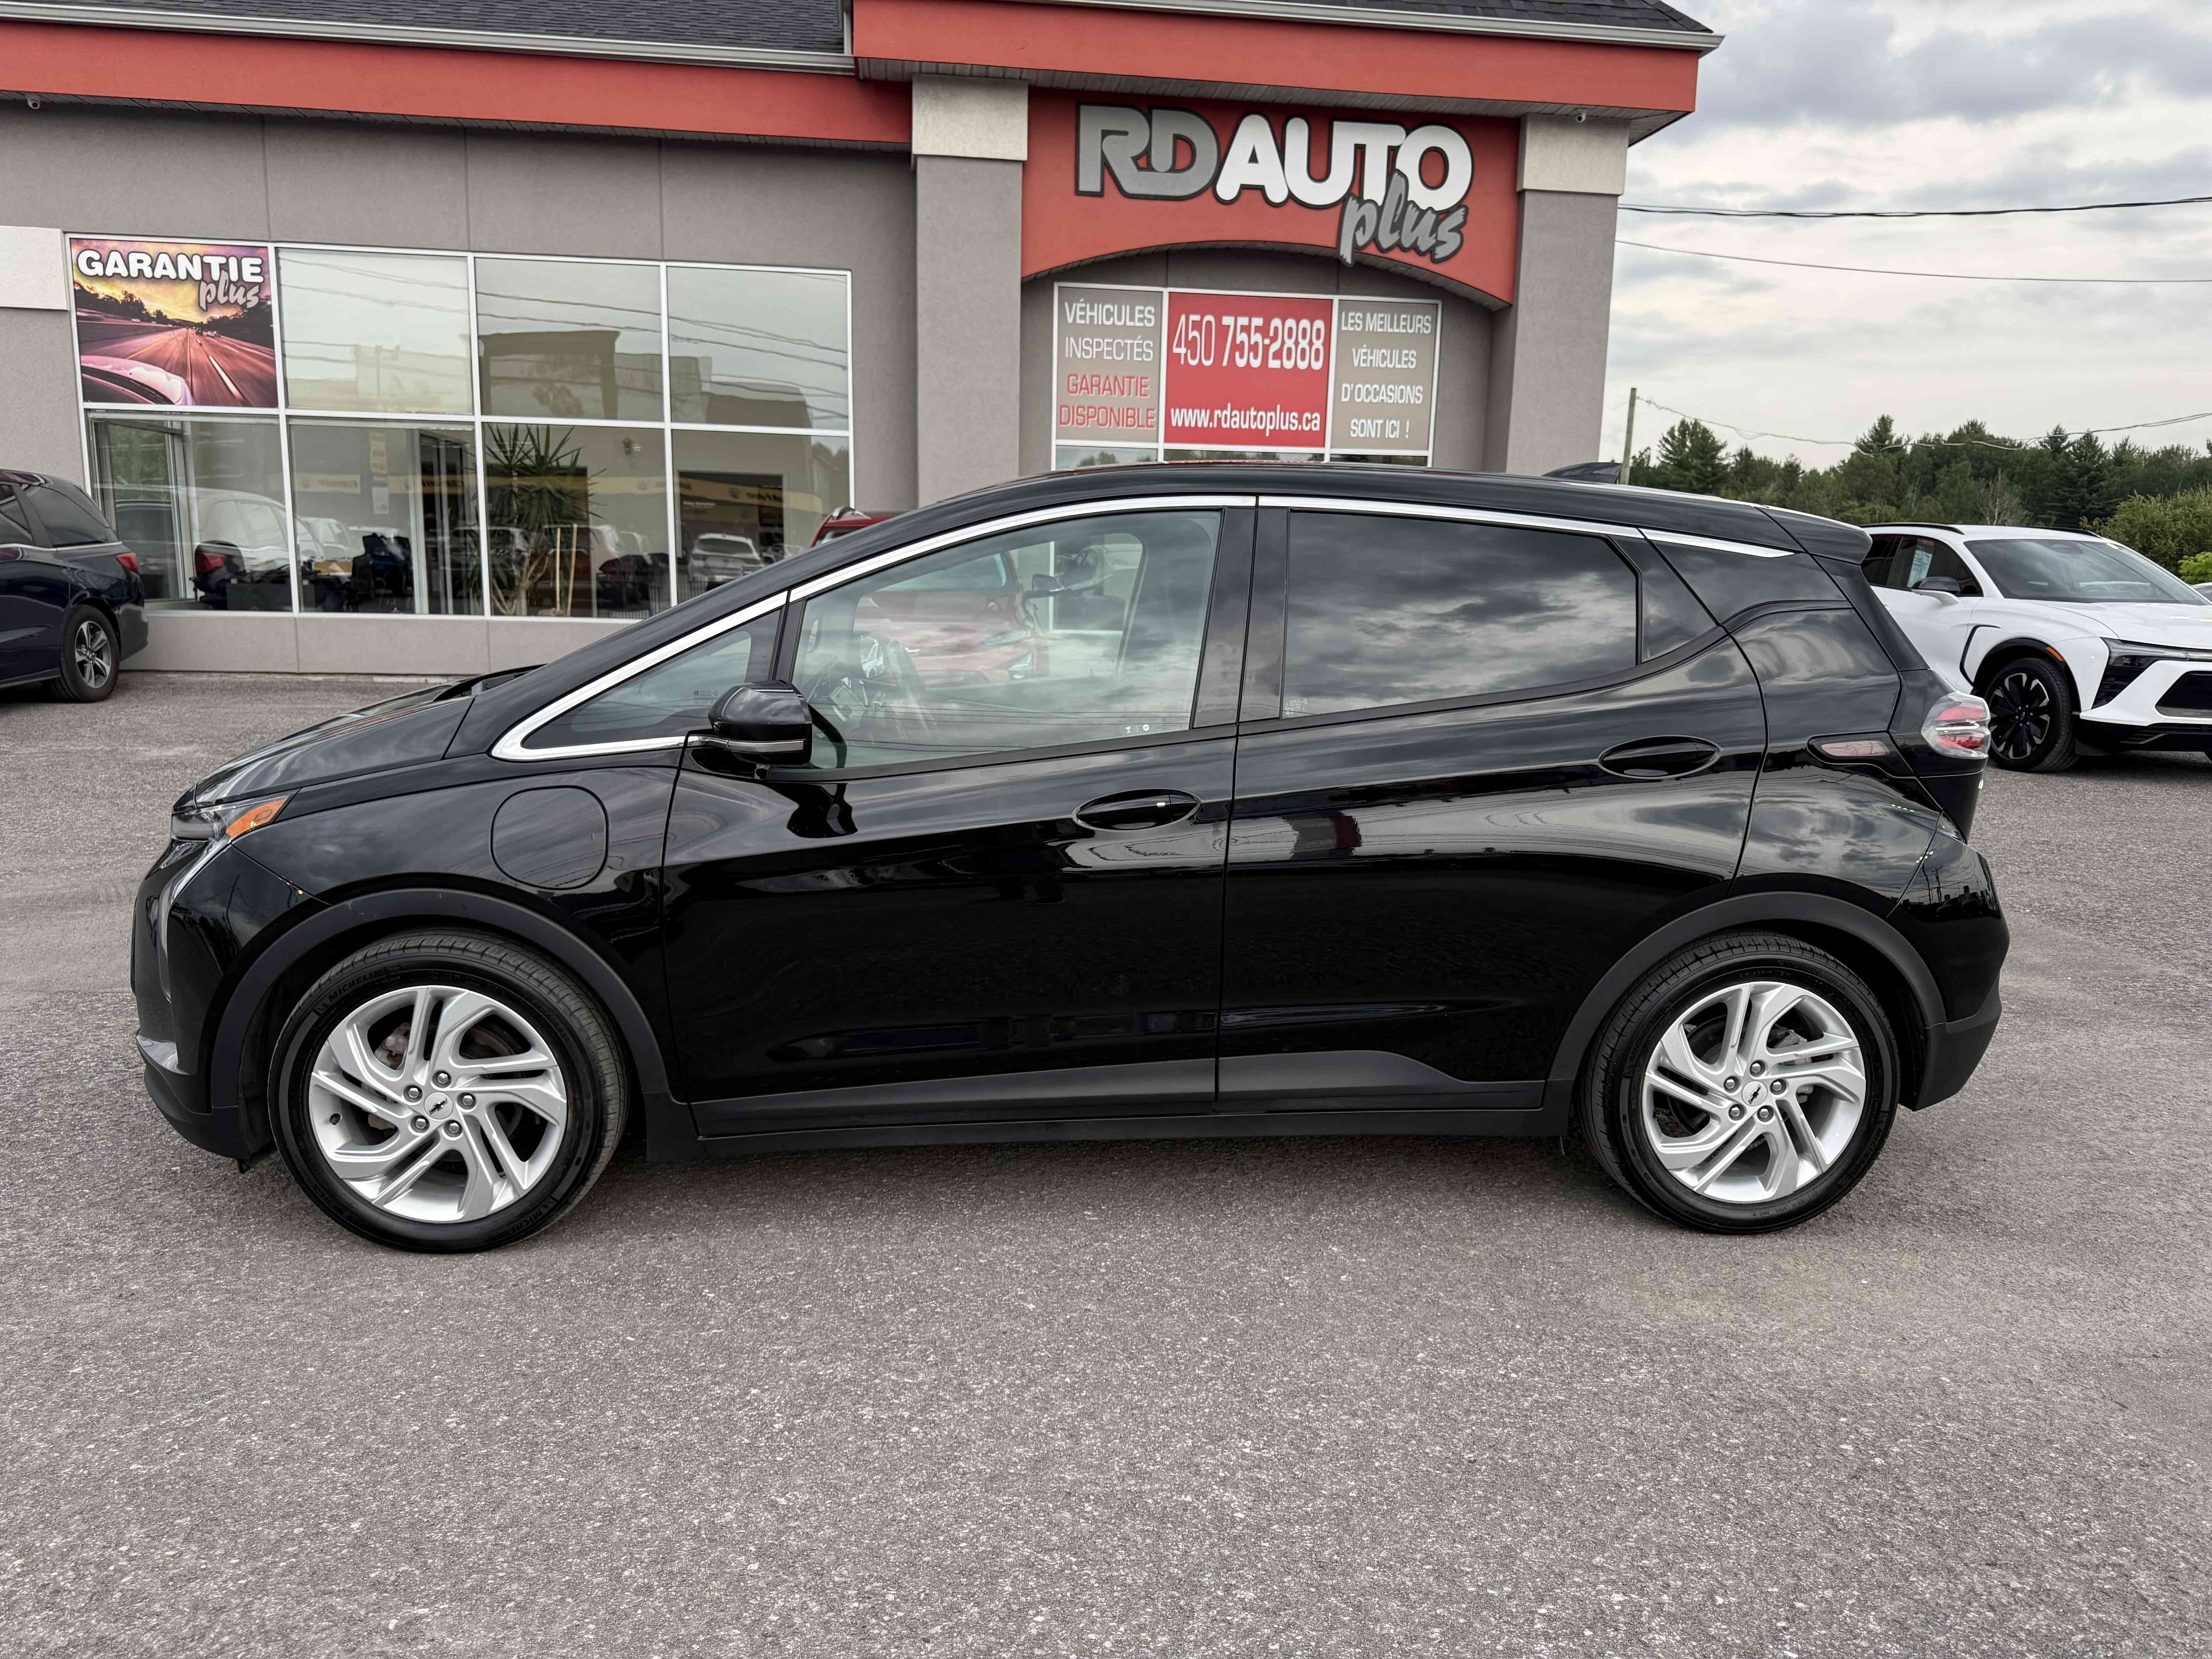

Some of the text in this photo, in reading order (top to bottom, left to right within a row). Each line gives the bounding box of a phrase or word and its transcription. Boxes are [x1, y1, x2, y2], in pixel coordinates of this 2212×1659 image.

[1339, 172, 1467, 265] plus
[77, 250, 264, 283] GARANTIE
[199, 270, 261, 311] plus
[1065, 298, 1155, 327] VÉHICULES
[1341, 312, 1432, 334] LES MEILLEURS
[1065, 335, 1154, 361] INSPECTÉS
[1172, 314, 1325, 370] 450 755-2888
[1352, 344, 1417, 369] VÉHICULES
[1067, 374, 1150, 398] GARANTIE
[1059, 405, 1156, 429] DISPONIBLE
[1170, 403, 1321, 437] www.rdautoplus.ca
[1350, 419, 1384, 438] SONT
[1385, 420, 1400, 438] ICI
